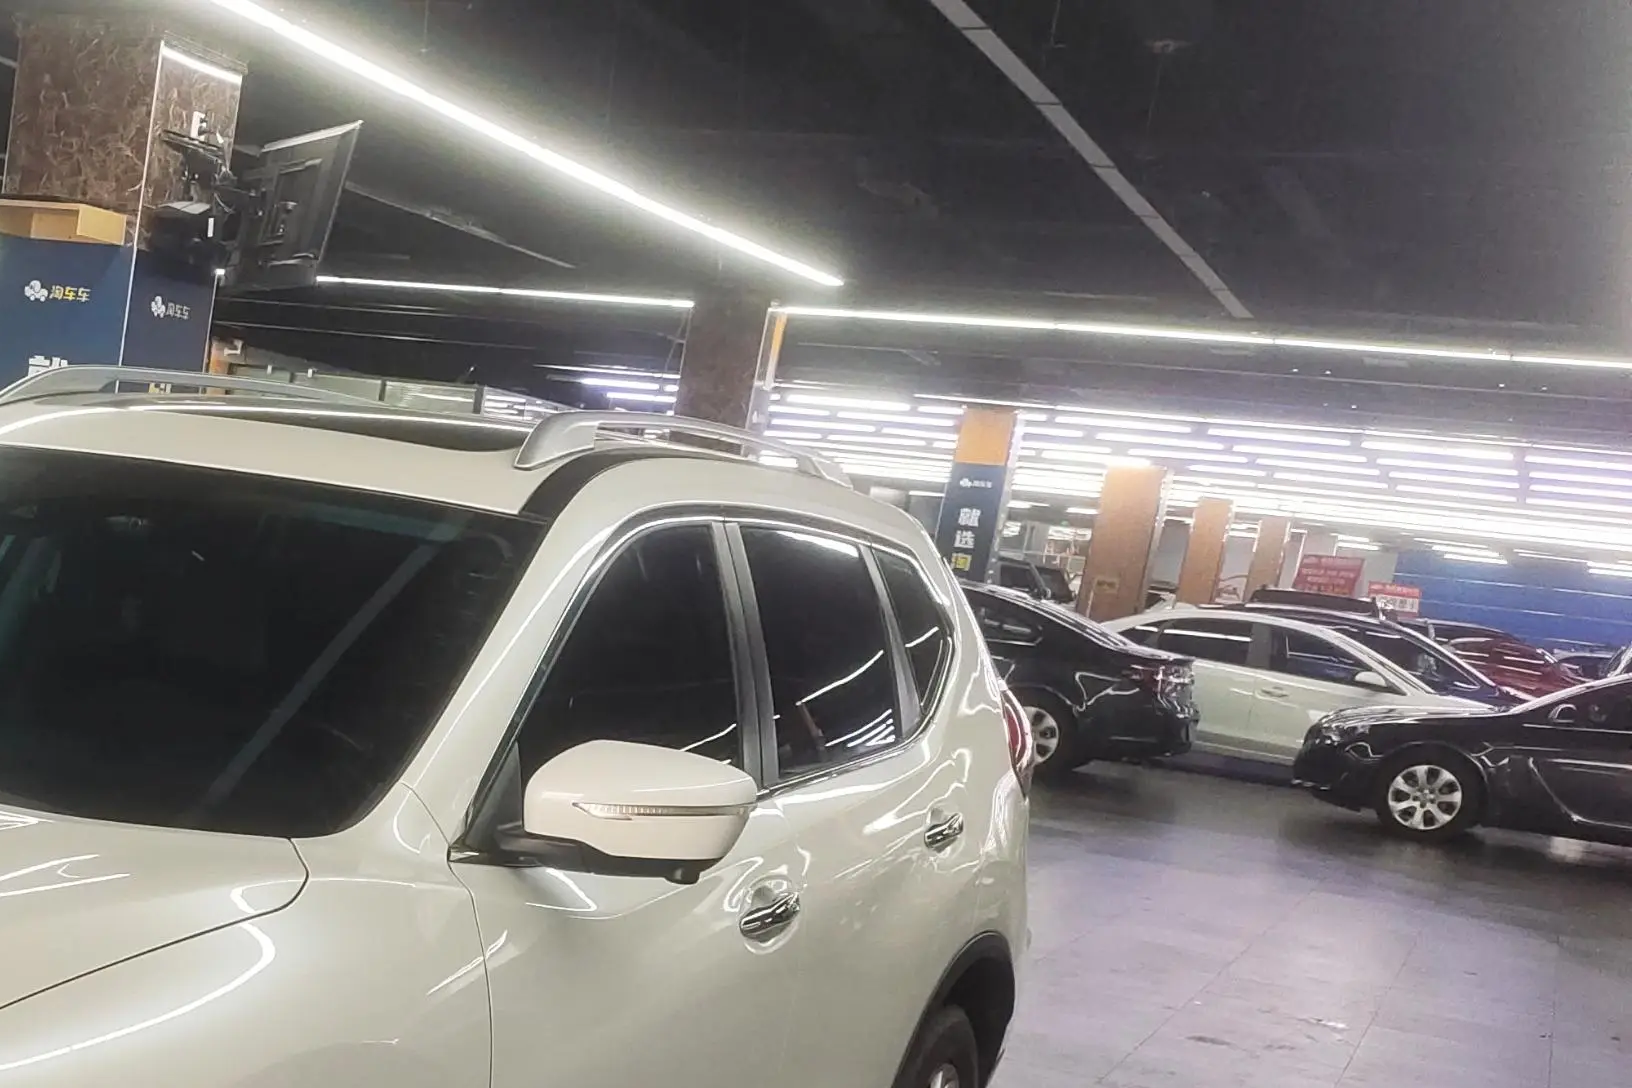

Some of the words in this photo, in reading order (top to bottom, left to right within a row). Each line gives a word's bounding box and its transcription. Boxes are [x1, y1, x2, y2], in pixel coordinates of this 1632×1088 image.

[49, 285, 91, 302] 淘车车
[165, 302, 190, 320] 淘车车
